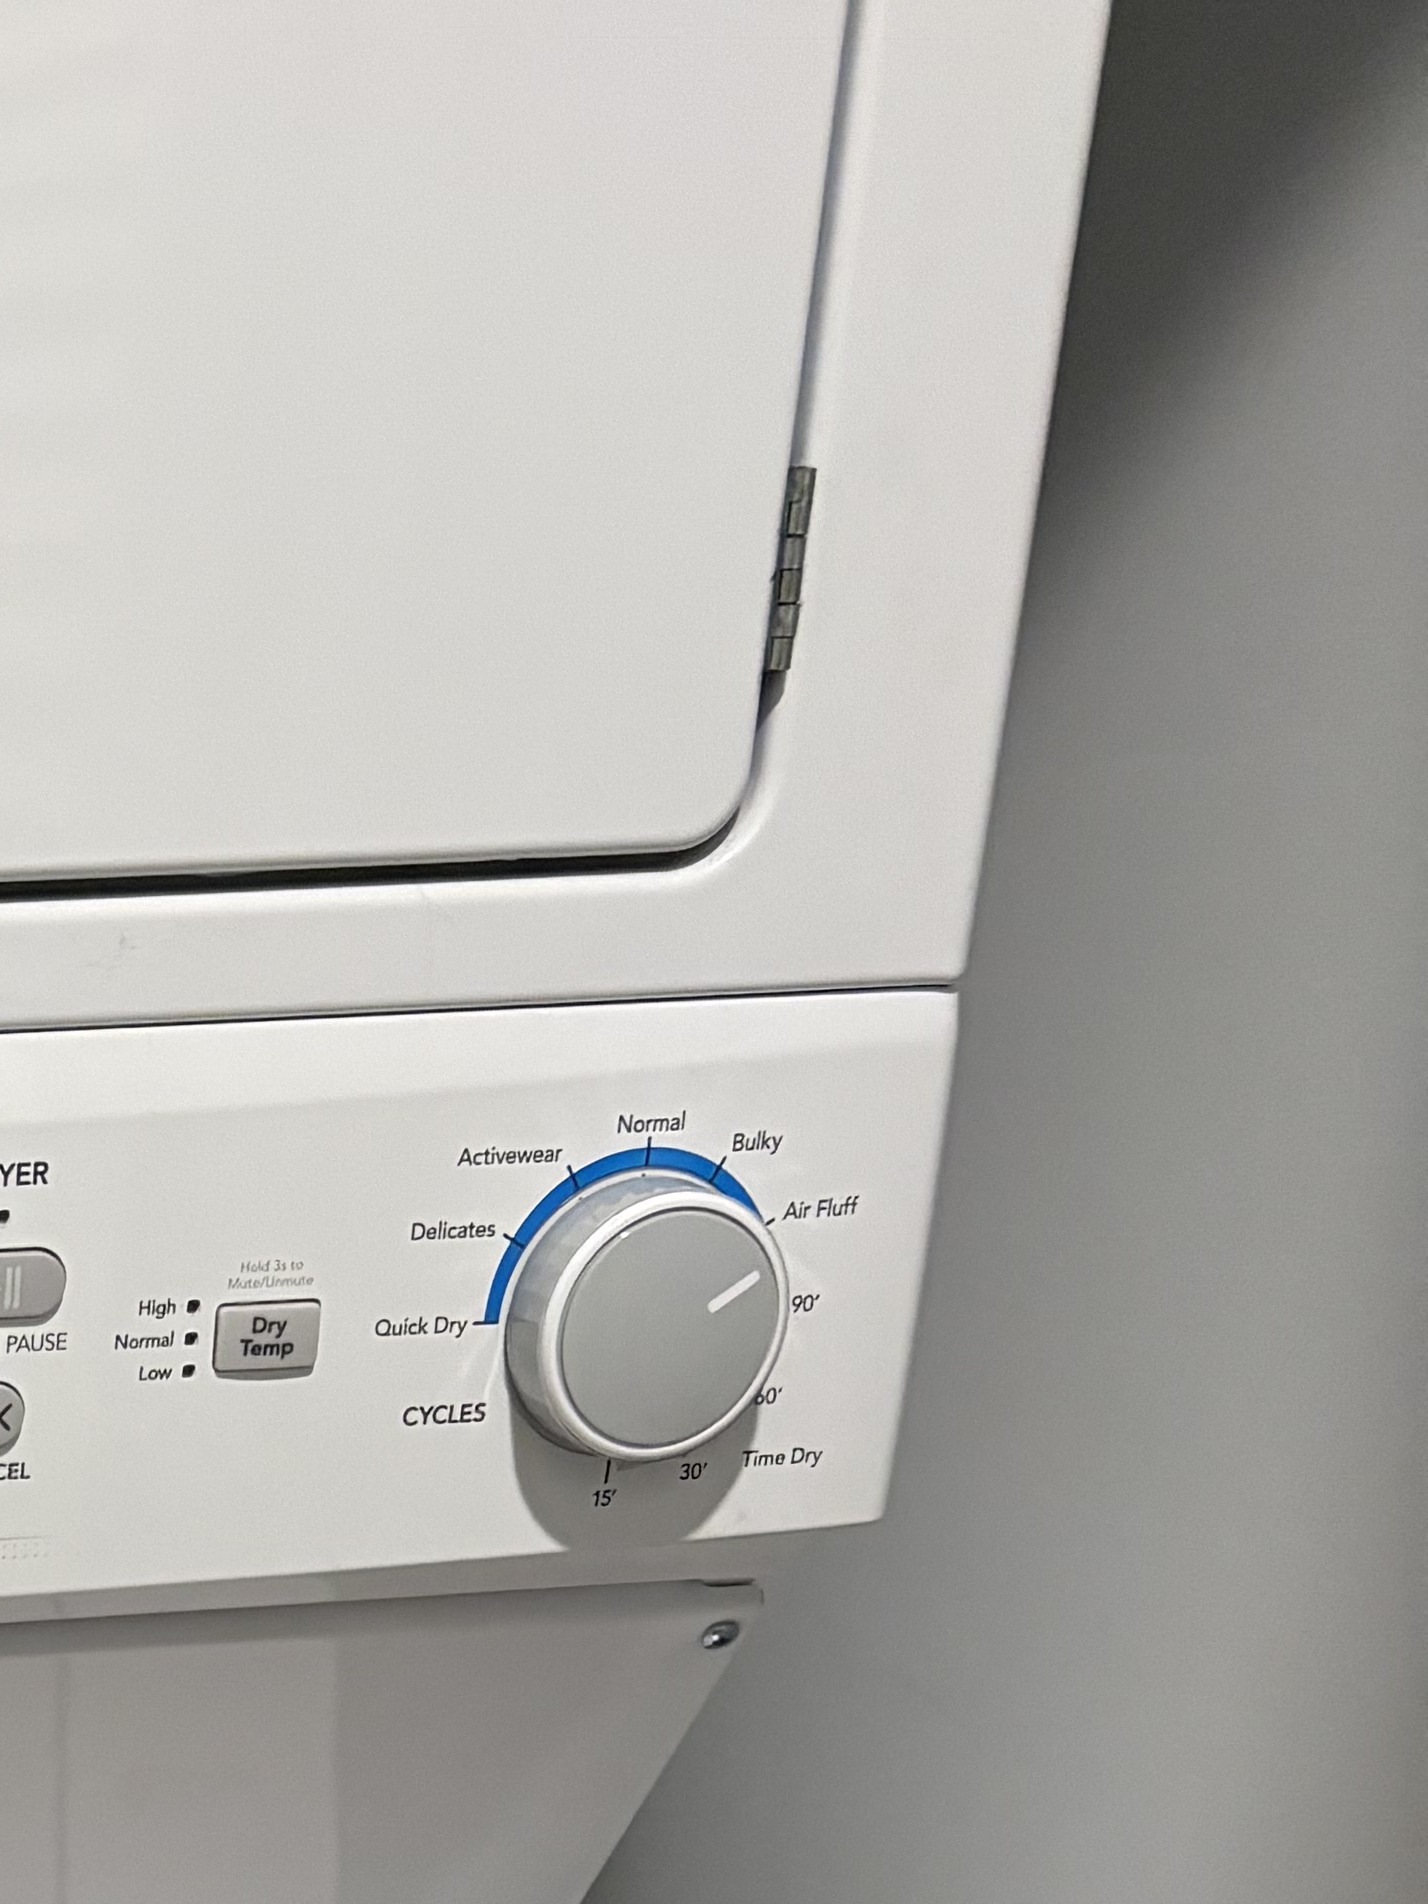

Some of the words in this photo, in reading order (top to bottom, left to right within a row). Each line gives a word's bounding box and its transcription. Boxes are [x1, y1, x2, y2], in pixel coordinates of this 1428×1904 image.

[617, 1111, 686, 1134] Normal
[732, 1132, 783, 1153] Bulky
[458, 1146, 562, 1167] Activewear
[783, 1201, 812, 1220] Air
[816, 1195, 858, 1218] Fluff
[410, 1222, 496, 1241] Delicates
[240, 1260, 270, 1273] Hold
[291, 1260, 304, 1271] to
[227, 1276, 314, 1290] Mute/Unmute
[139, 1298, 176, 1319] High
[252, 1317, 287, 1338] Dry
[375, 1318, 427, 1337] Quick
[434, 1316, 467, 1336] Dry
[7, 1333, 67, 1353] PAUSE
[115, 1331, 174, 1349] Normal
[240, 1339, 294, 1359] Temp
[139, 1366, 173, 1381] Low
[403, 1403, 486, 1426] CYCLES
[743, 1450, 785, 1468] Time
[791, 1447, 823, 1468] Dry
